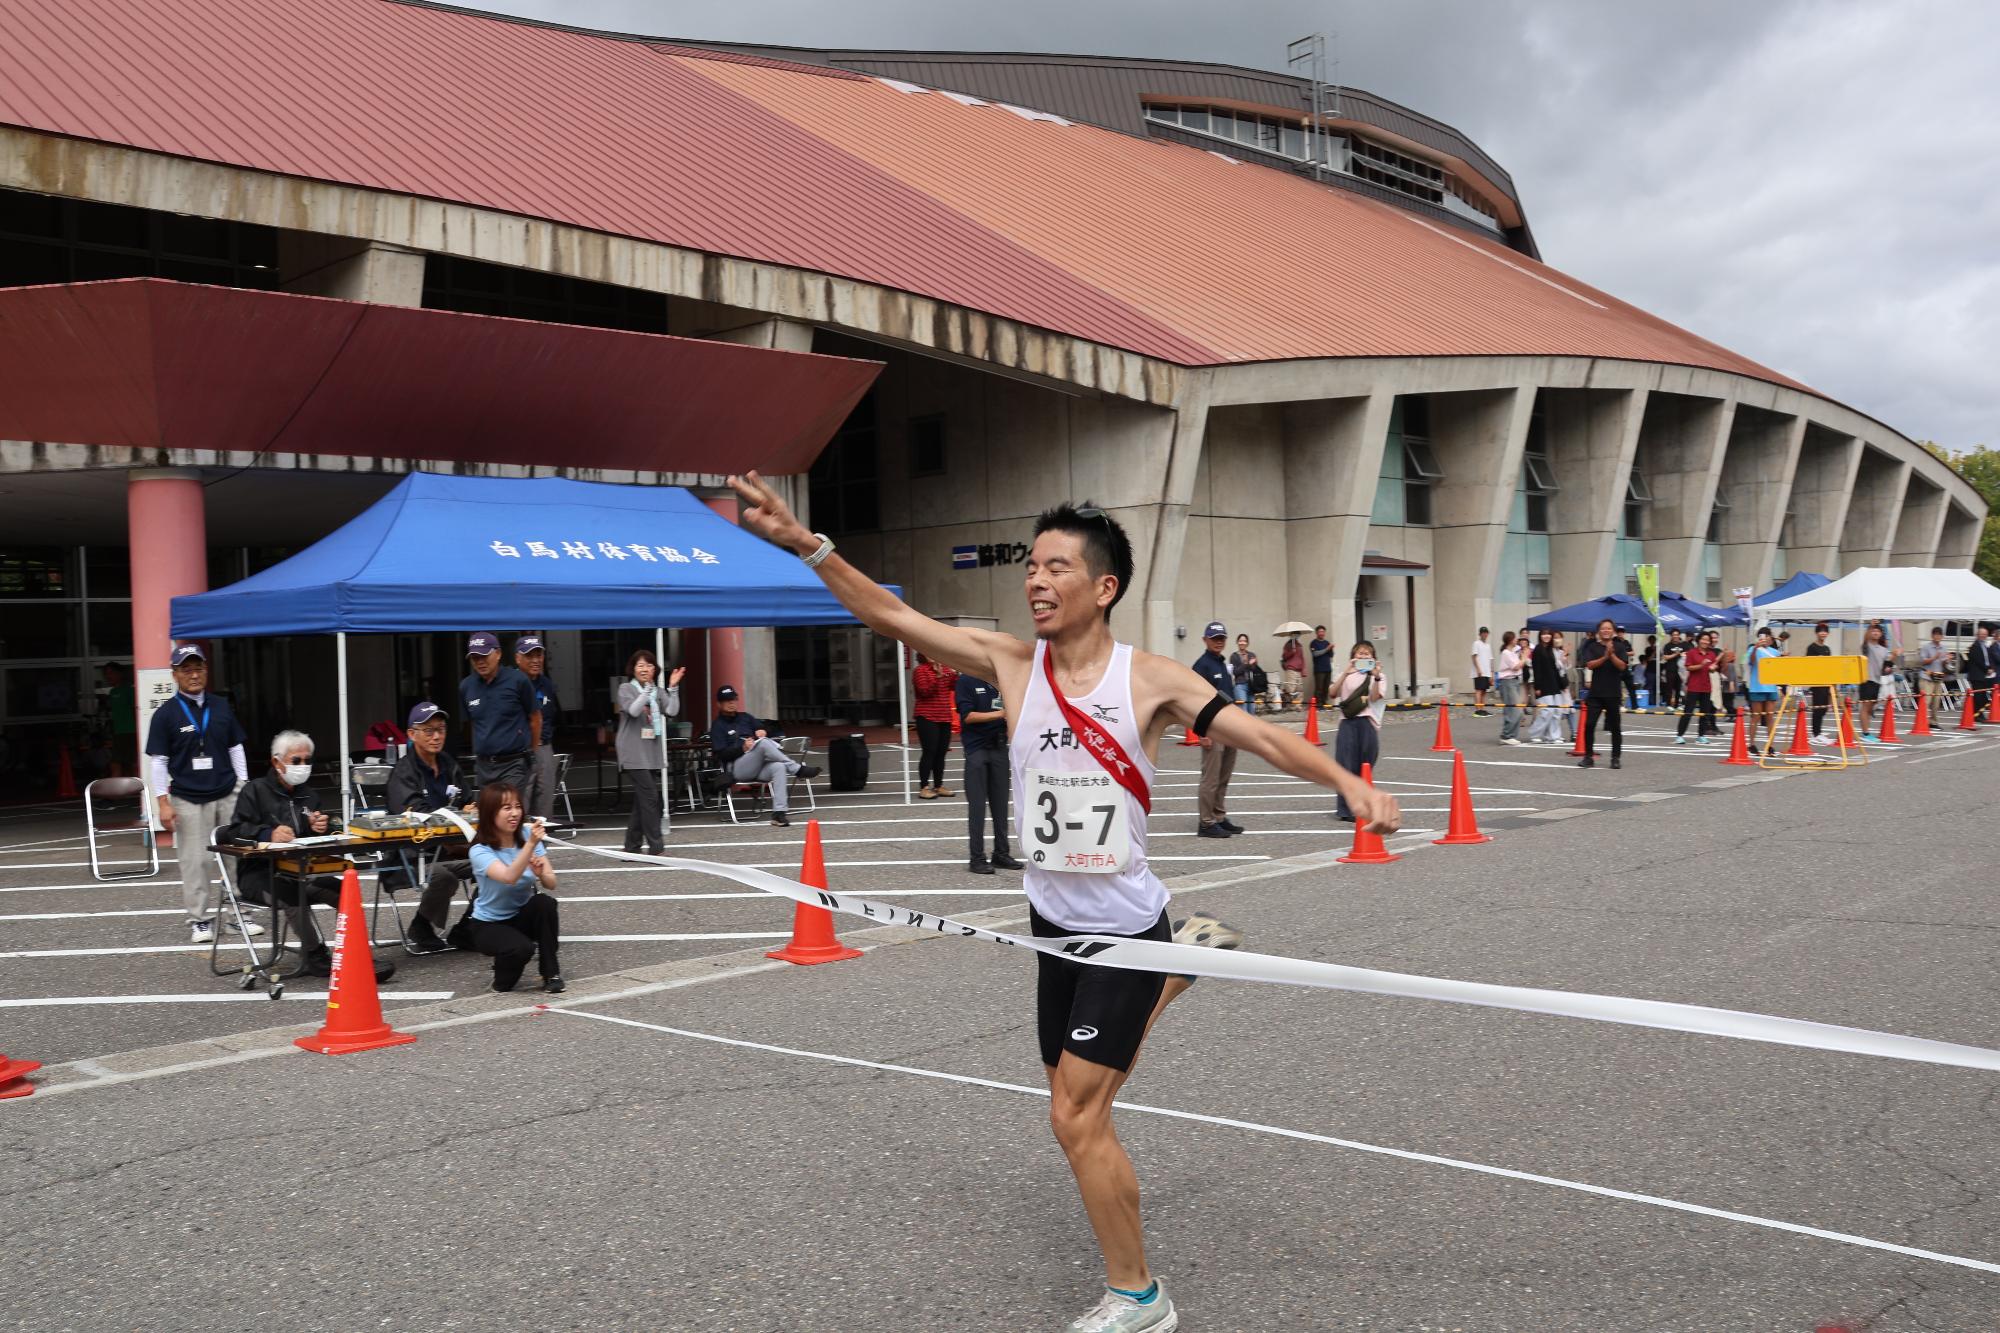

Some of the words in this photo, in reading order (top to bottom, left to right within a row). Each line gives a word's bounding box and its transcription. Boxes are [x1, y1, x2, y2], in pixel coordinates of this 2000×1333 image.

[489, 540, 721, 564] 白馬村体育協会
[979, 541, 1032, 567] 協和ウ
[1039, 727, 1080, 752] 大町
[1034, 790, 1117, 846] 3-7
[1064, 852, 1118, 868] 大町市A
